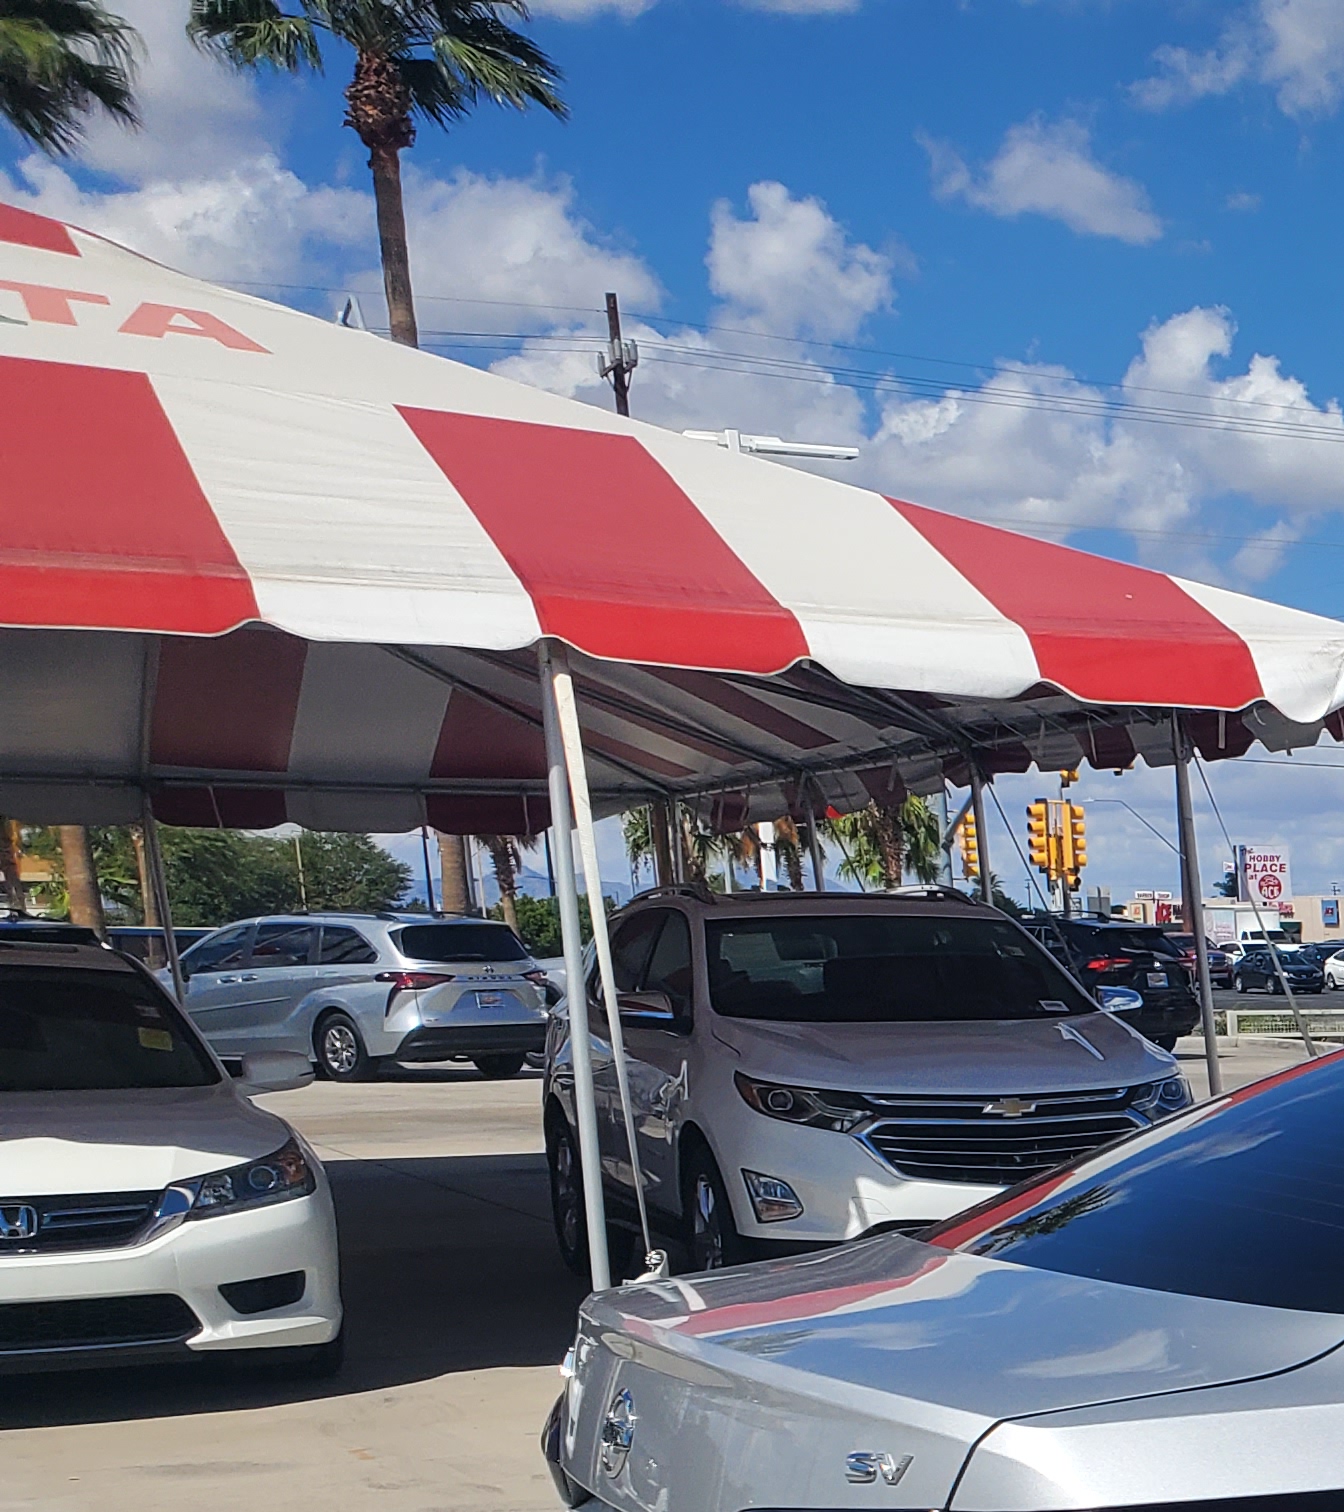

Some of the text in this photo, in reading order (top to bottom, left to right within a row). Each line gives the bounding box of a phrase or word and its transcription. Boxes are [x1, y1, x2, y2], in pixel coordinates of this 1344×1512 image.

[1244, 863, 1287, 873] PLACE
[1261, 886, 1280, 898] ACE
[845, 1450, 915, 1487] SV
